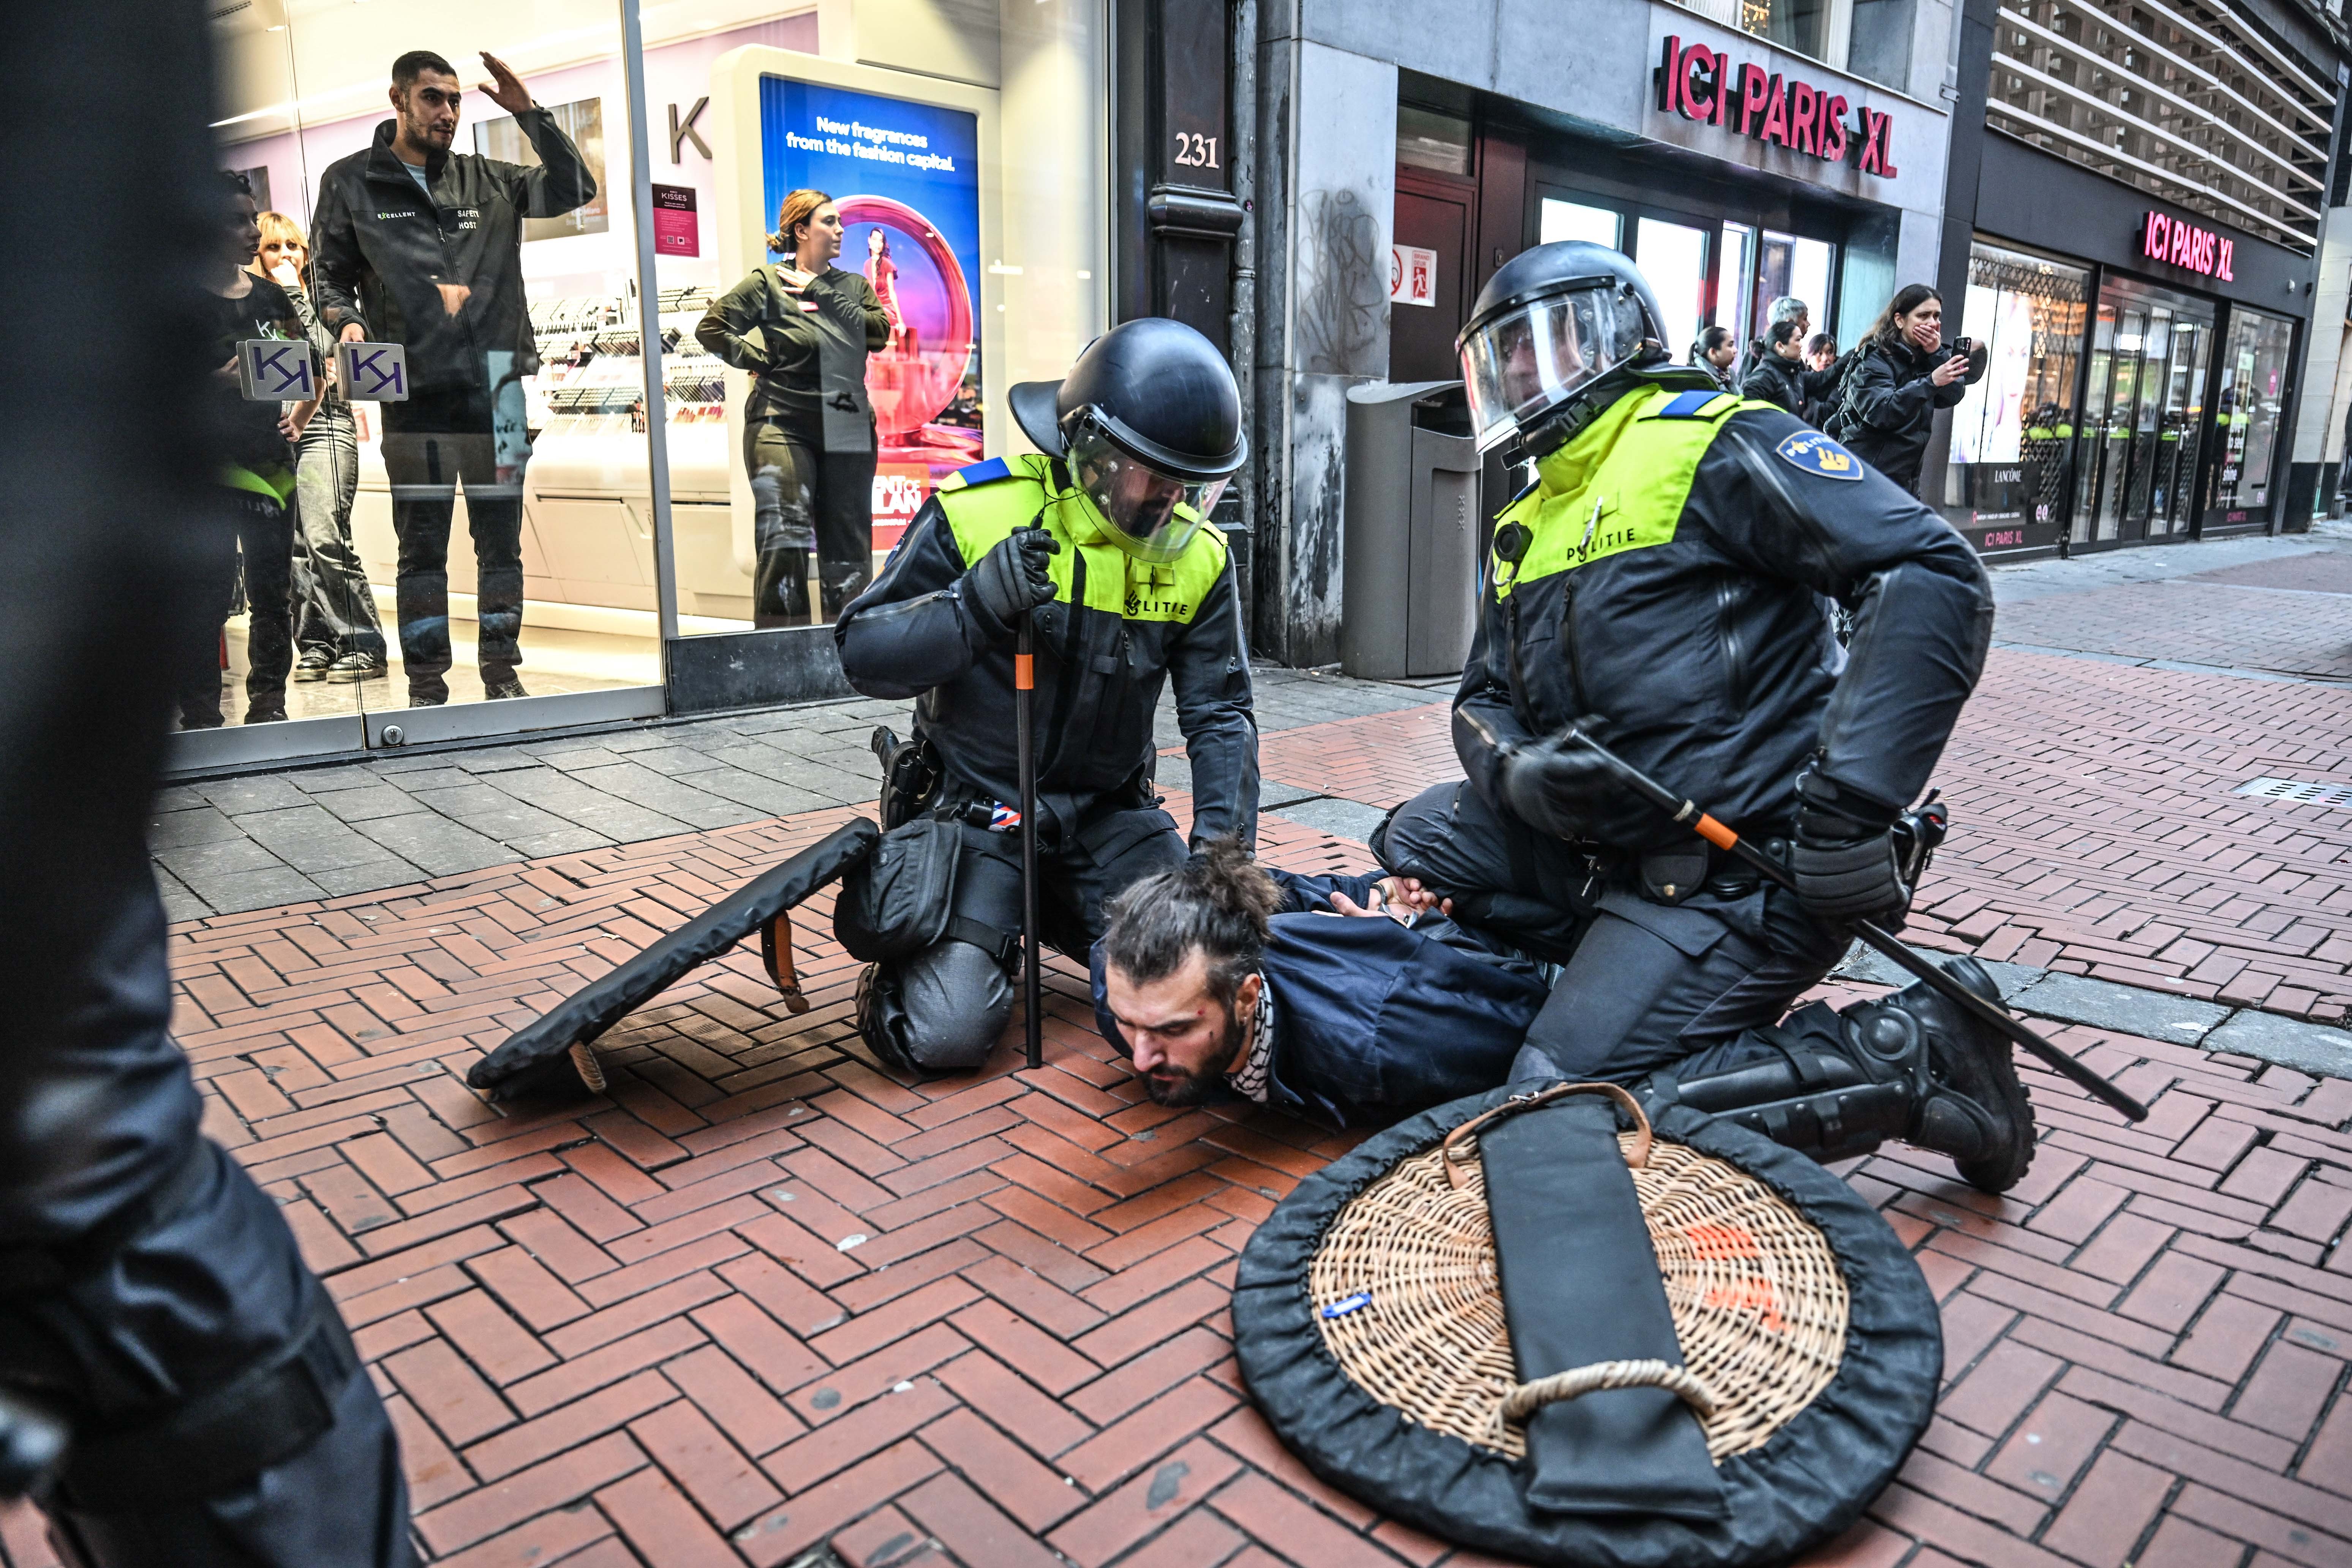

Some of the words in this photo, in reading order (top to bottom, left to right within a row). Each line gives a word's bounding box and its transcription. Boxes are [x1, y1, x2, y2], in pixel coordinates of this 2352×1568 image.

[1658, 35, 1728, 125] ICI
[1733, 63, 1848, 161] PARIS
[1857, 107, 1897, 178] XL
[816, 116, 850, 136] New
[851, 122, 928, 148] fragrances
[786, 132, 824, 152] from
[826, 138, 851, 156] the
[853, 142, 905, 164] fashion
[906, 153, 955, 172] capital.
[1175, 132, 1219, 169] 231
[661, 193, 687, 201] KISSES
[377, 212, 416, 220] EXCELLENT
[457, 210, 479, 218] SAFETY
[2145, 211, 2171, 261] ICI
[2171, 220, 2216, 275] PARIS
[2216, 237, 2233, 282] XL
[1995, 468, 2022, 483] LANCÔME
[873, 476, 906, 494] ENT
[904, 480, 921, 493] OF
[1985, 533, 1995, 547] ICI
[1995, 531, 2013, 545] PARIS
[2015, 530, 2023, 544] XL
[1125, 600, 1188, 616] OLITIE
